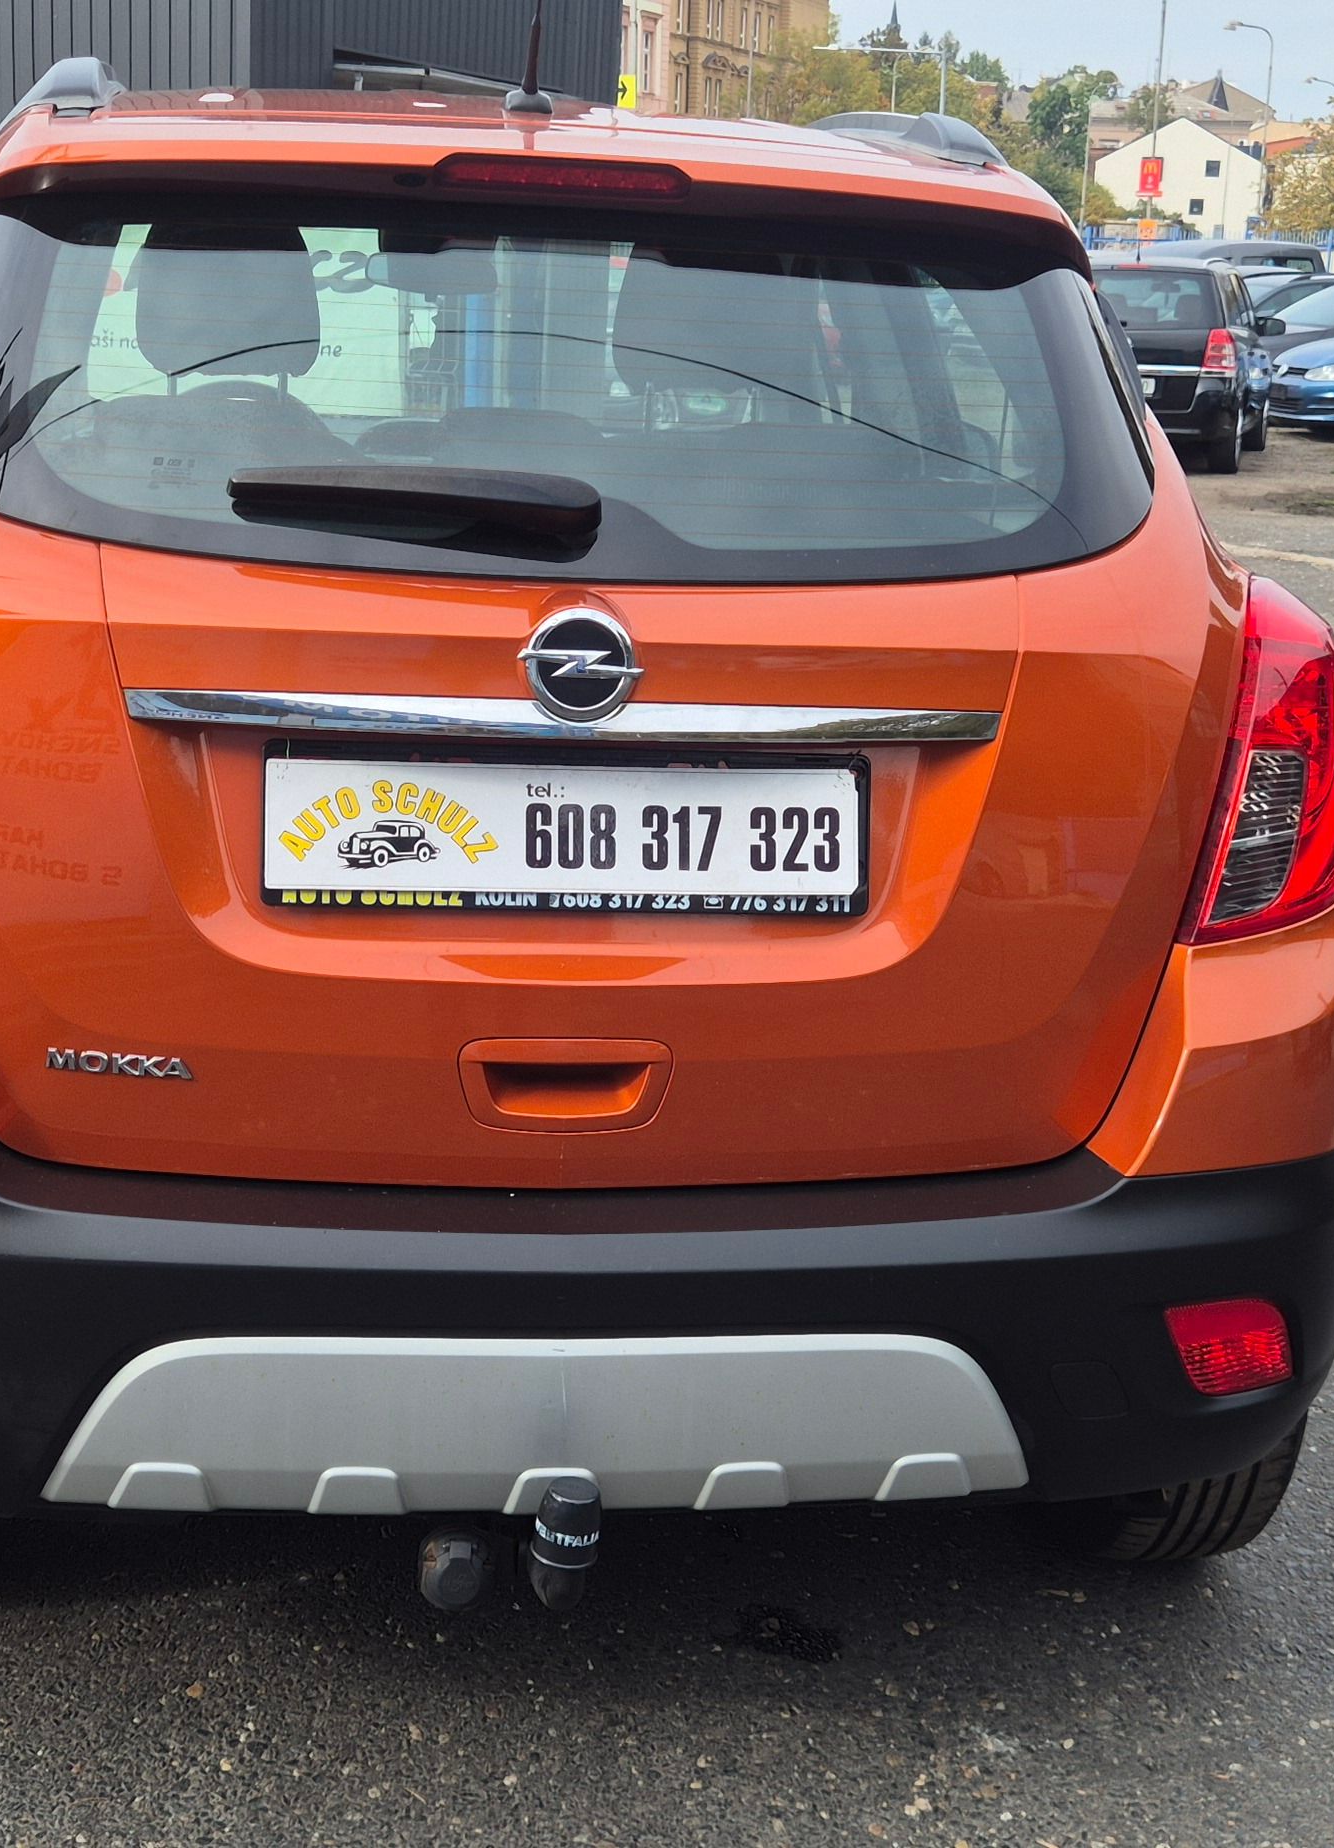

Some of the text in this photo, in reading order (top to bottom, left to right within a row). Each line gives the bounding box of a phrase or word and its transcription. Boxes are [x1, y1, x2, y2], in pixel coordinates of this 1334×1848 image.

[526, 782, 565, 798] tel.:
[278, 780, 499, 864] AUTO SCHULZ
[525, 803, 840, 872] 608 317 323
[46, 1046, 195, 1080] MOKKA
